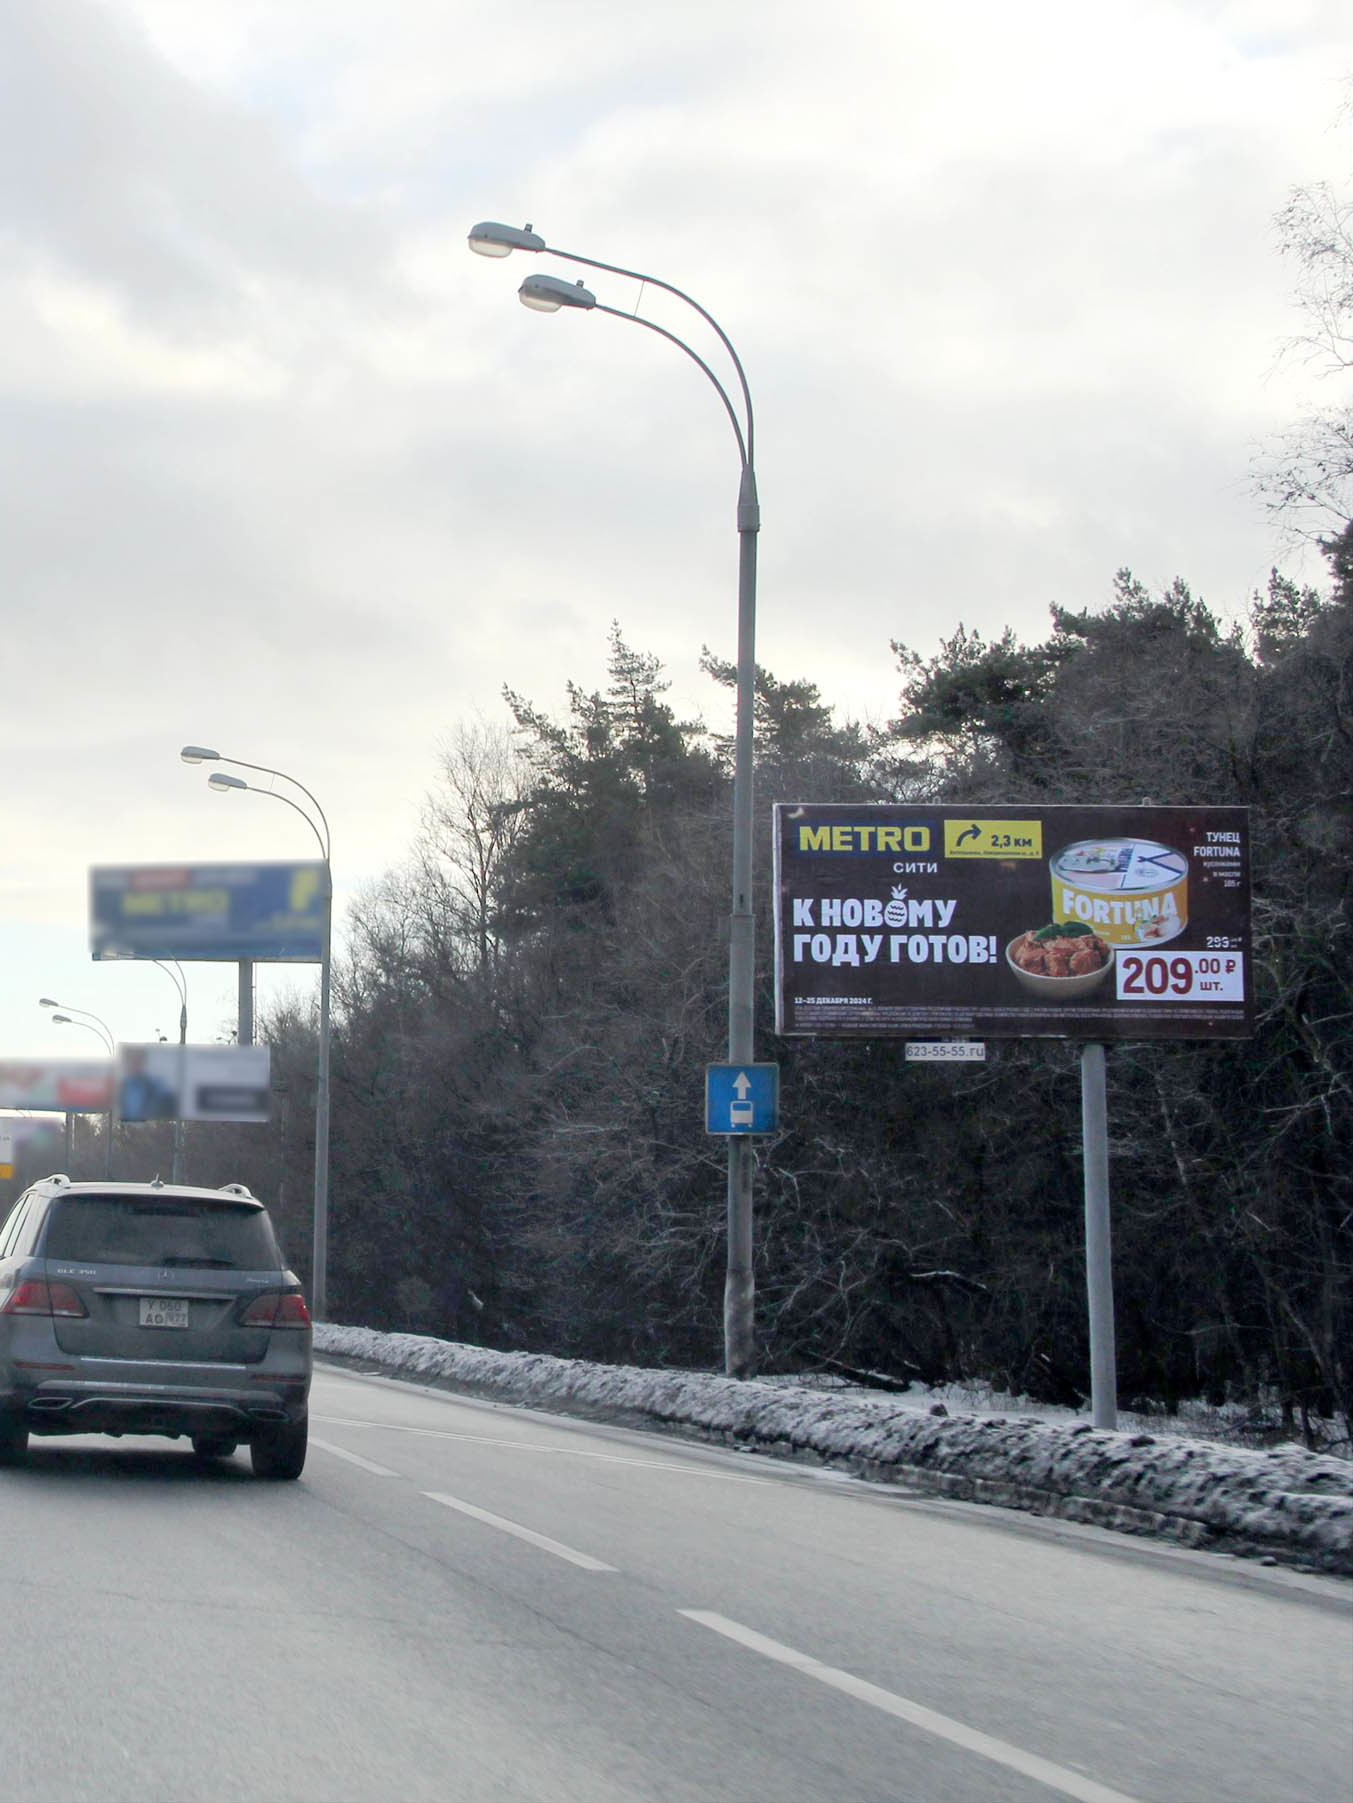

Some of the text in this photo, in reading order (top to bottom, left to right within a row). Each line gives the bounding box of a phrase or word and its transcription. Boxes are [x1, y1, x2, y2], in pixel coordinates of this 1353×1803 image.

[799, 826, 930, 852] METRO
[991, 835, 1011, 849] 2,3
[1206, 832, 1240, 843] ТУНЕЦ
[1193, 846, 1240, 857] FORTUNA
[893, 862, 938, 873] СИТИ
[1062, 887, 1178, 925] FORTUNA
[793, 898, 957, 928] К НОВОМУ
[793, 934, 998, 967] ГОДУ ГОТОВ!
[1199, 981, 1224, 991] шт.
[906, 1046, 984, 1057] 623-55-55.ru
